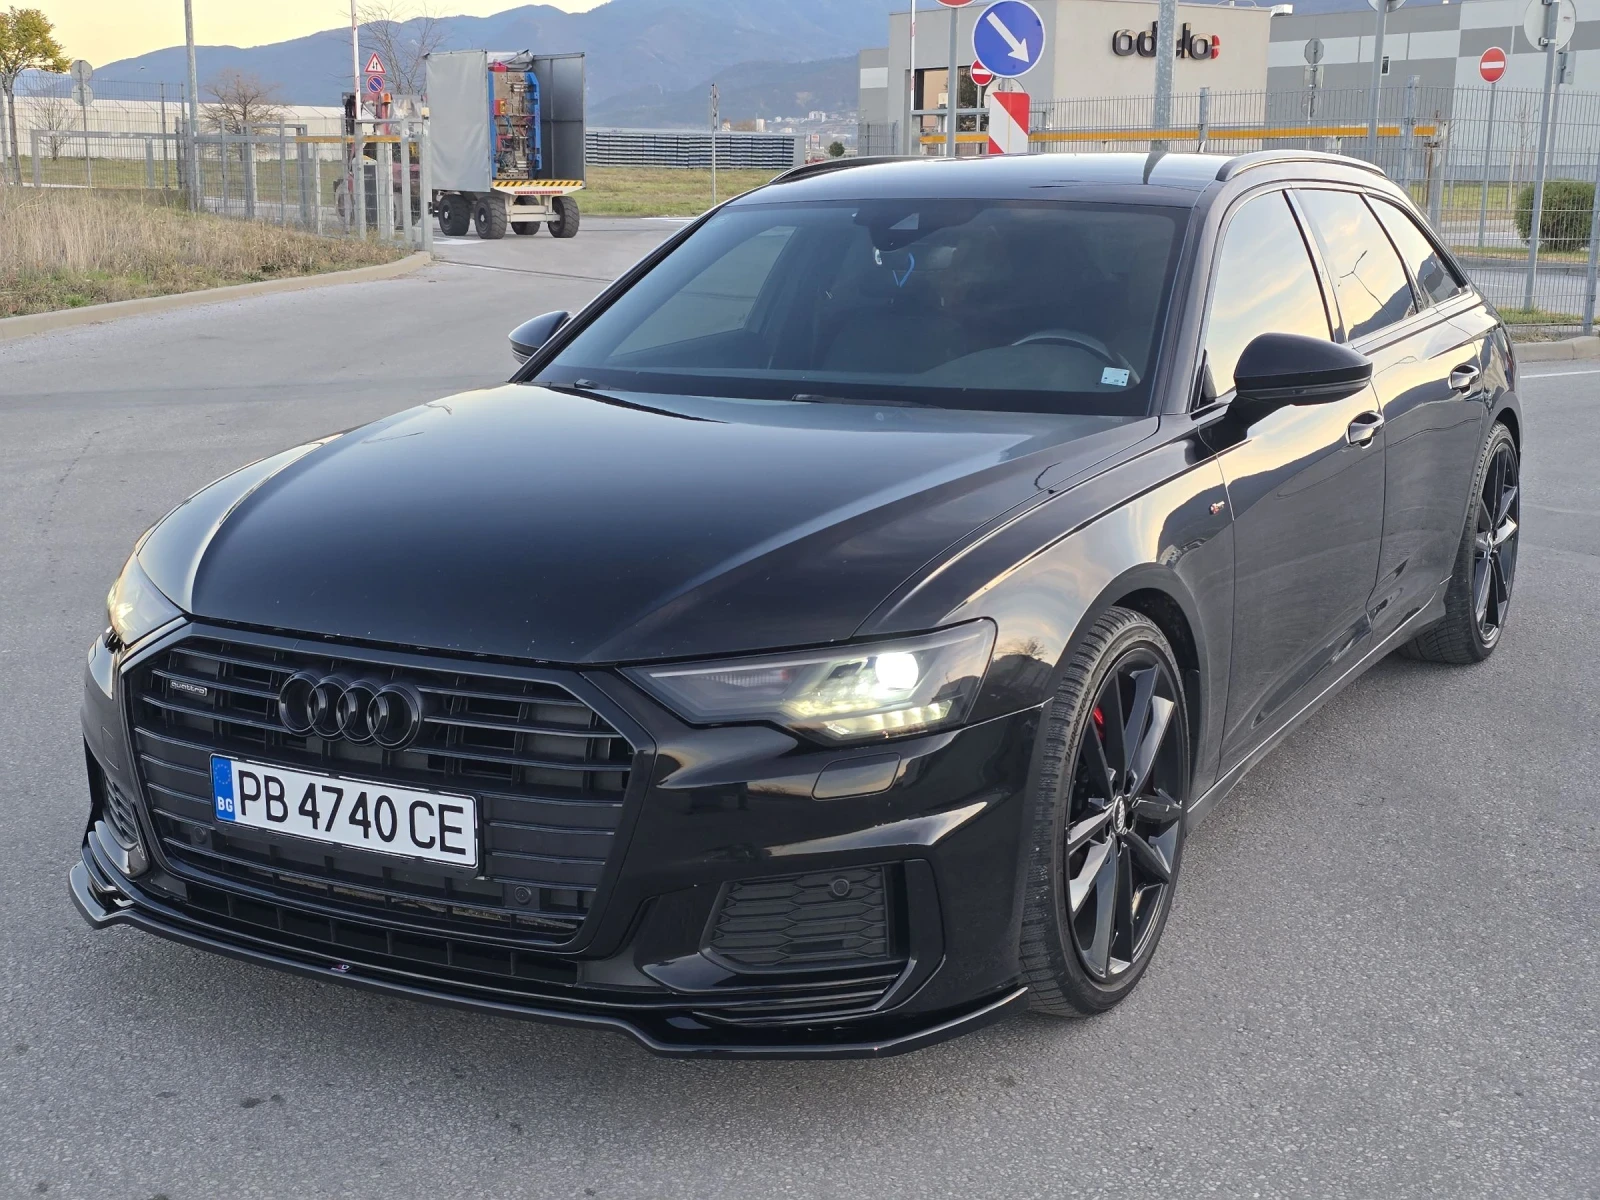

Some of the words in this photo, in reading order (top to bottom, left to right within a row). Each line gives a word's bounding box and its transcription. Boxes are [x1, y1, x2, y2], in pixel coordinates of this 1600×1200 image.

[1112, 20, 1213, 60] odlo
[171, 681, 205, 694] quattro
[217, 796, 234, 812] BG
[238, 769, 289, 823] PB
[298, 782, 398, 843] 4740
[409, 800, 466, 855] CE
